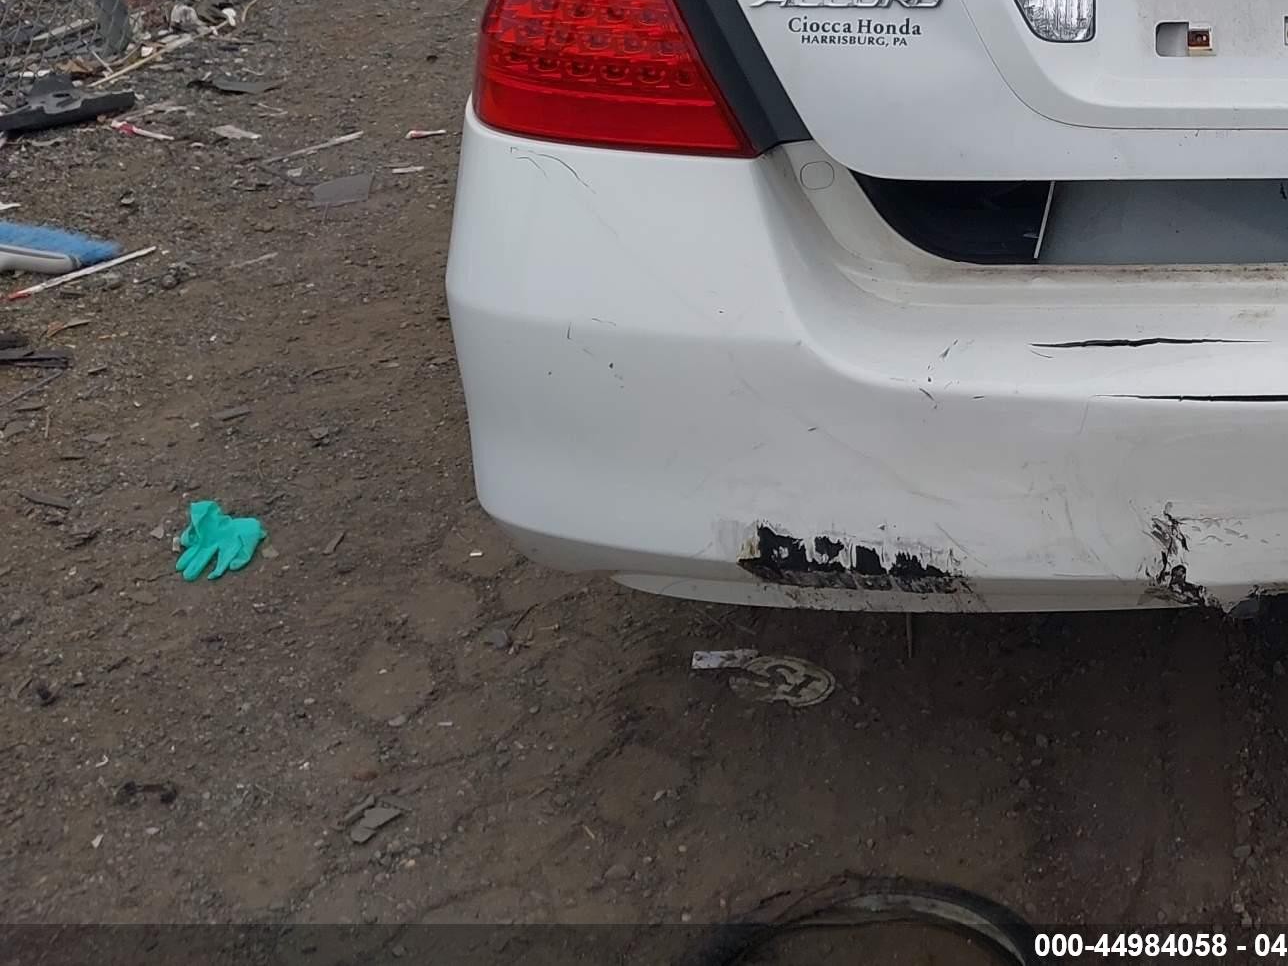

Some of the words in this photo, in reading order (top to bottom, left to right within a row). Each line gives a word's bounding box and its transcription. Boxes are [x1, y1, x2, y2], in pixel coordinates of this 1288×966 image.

[788, 16, 851, 33] Ciocca
[857, 17, 922, 36] Honda
[801, 35, 889, 47] HARRISBURG,
[892, 37, 908, 46] PA
